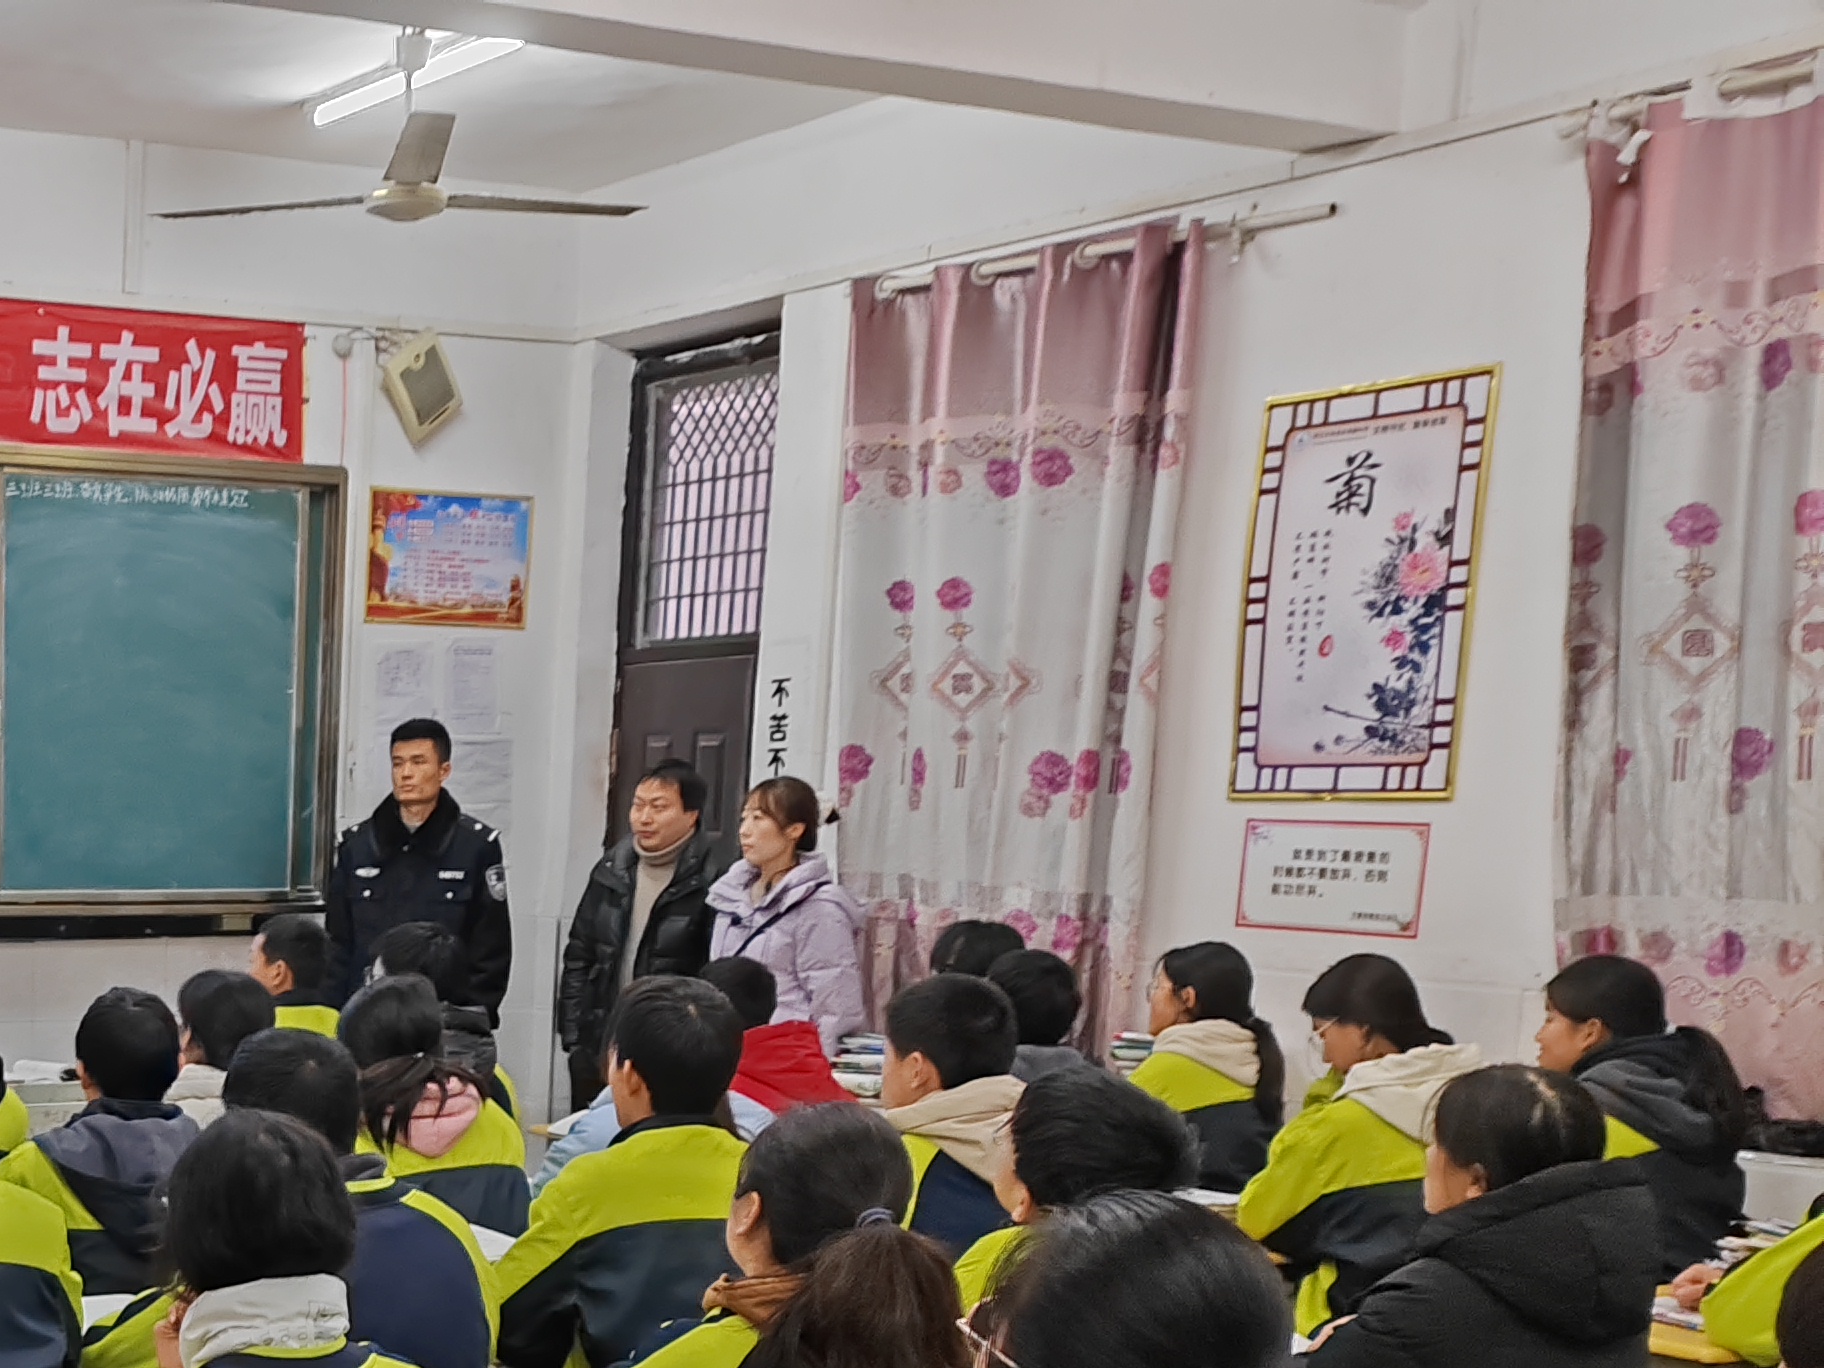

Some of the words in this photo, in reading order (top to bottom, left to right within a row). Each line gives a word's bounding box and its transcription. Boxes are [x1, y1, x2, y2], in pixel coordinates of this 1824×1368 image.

[30, 325, 289, 449] 志在必赢
[1323, 449, 1384, 517] 菊
[767, 677, 792, 776] 不苦不
